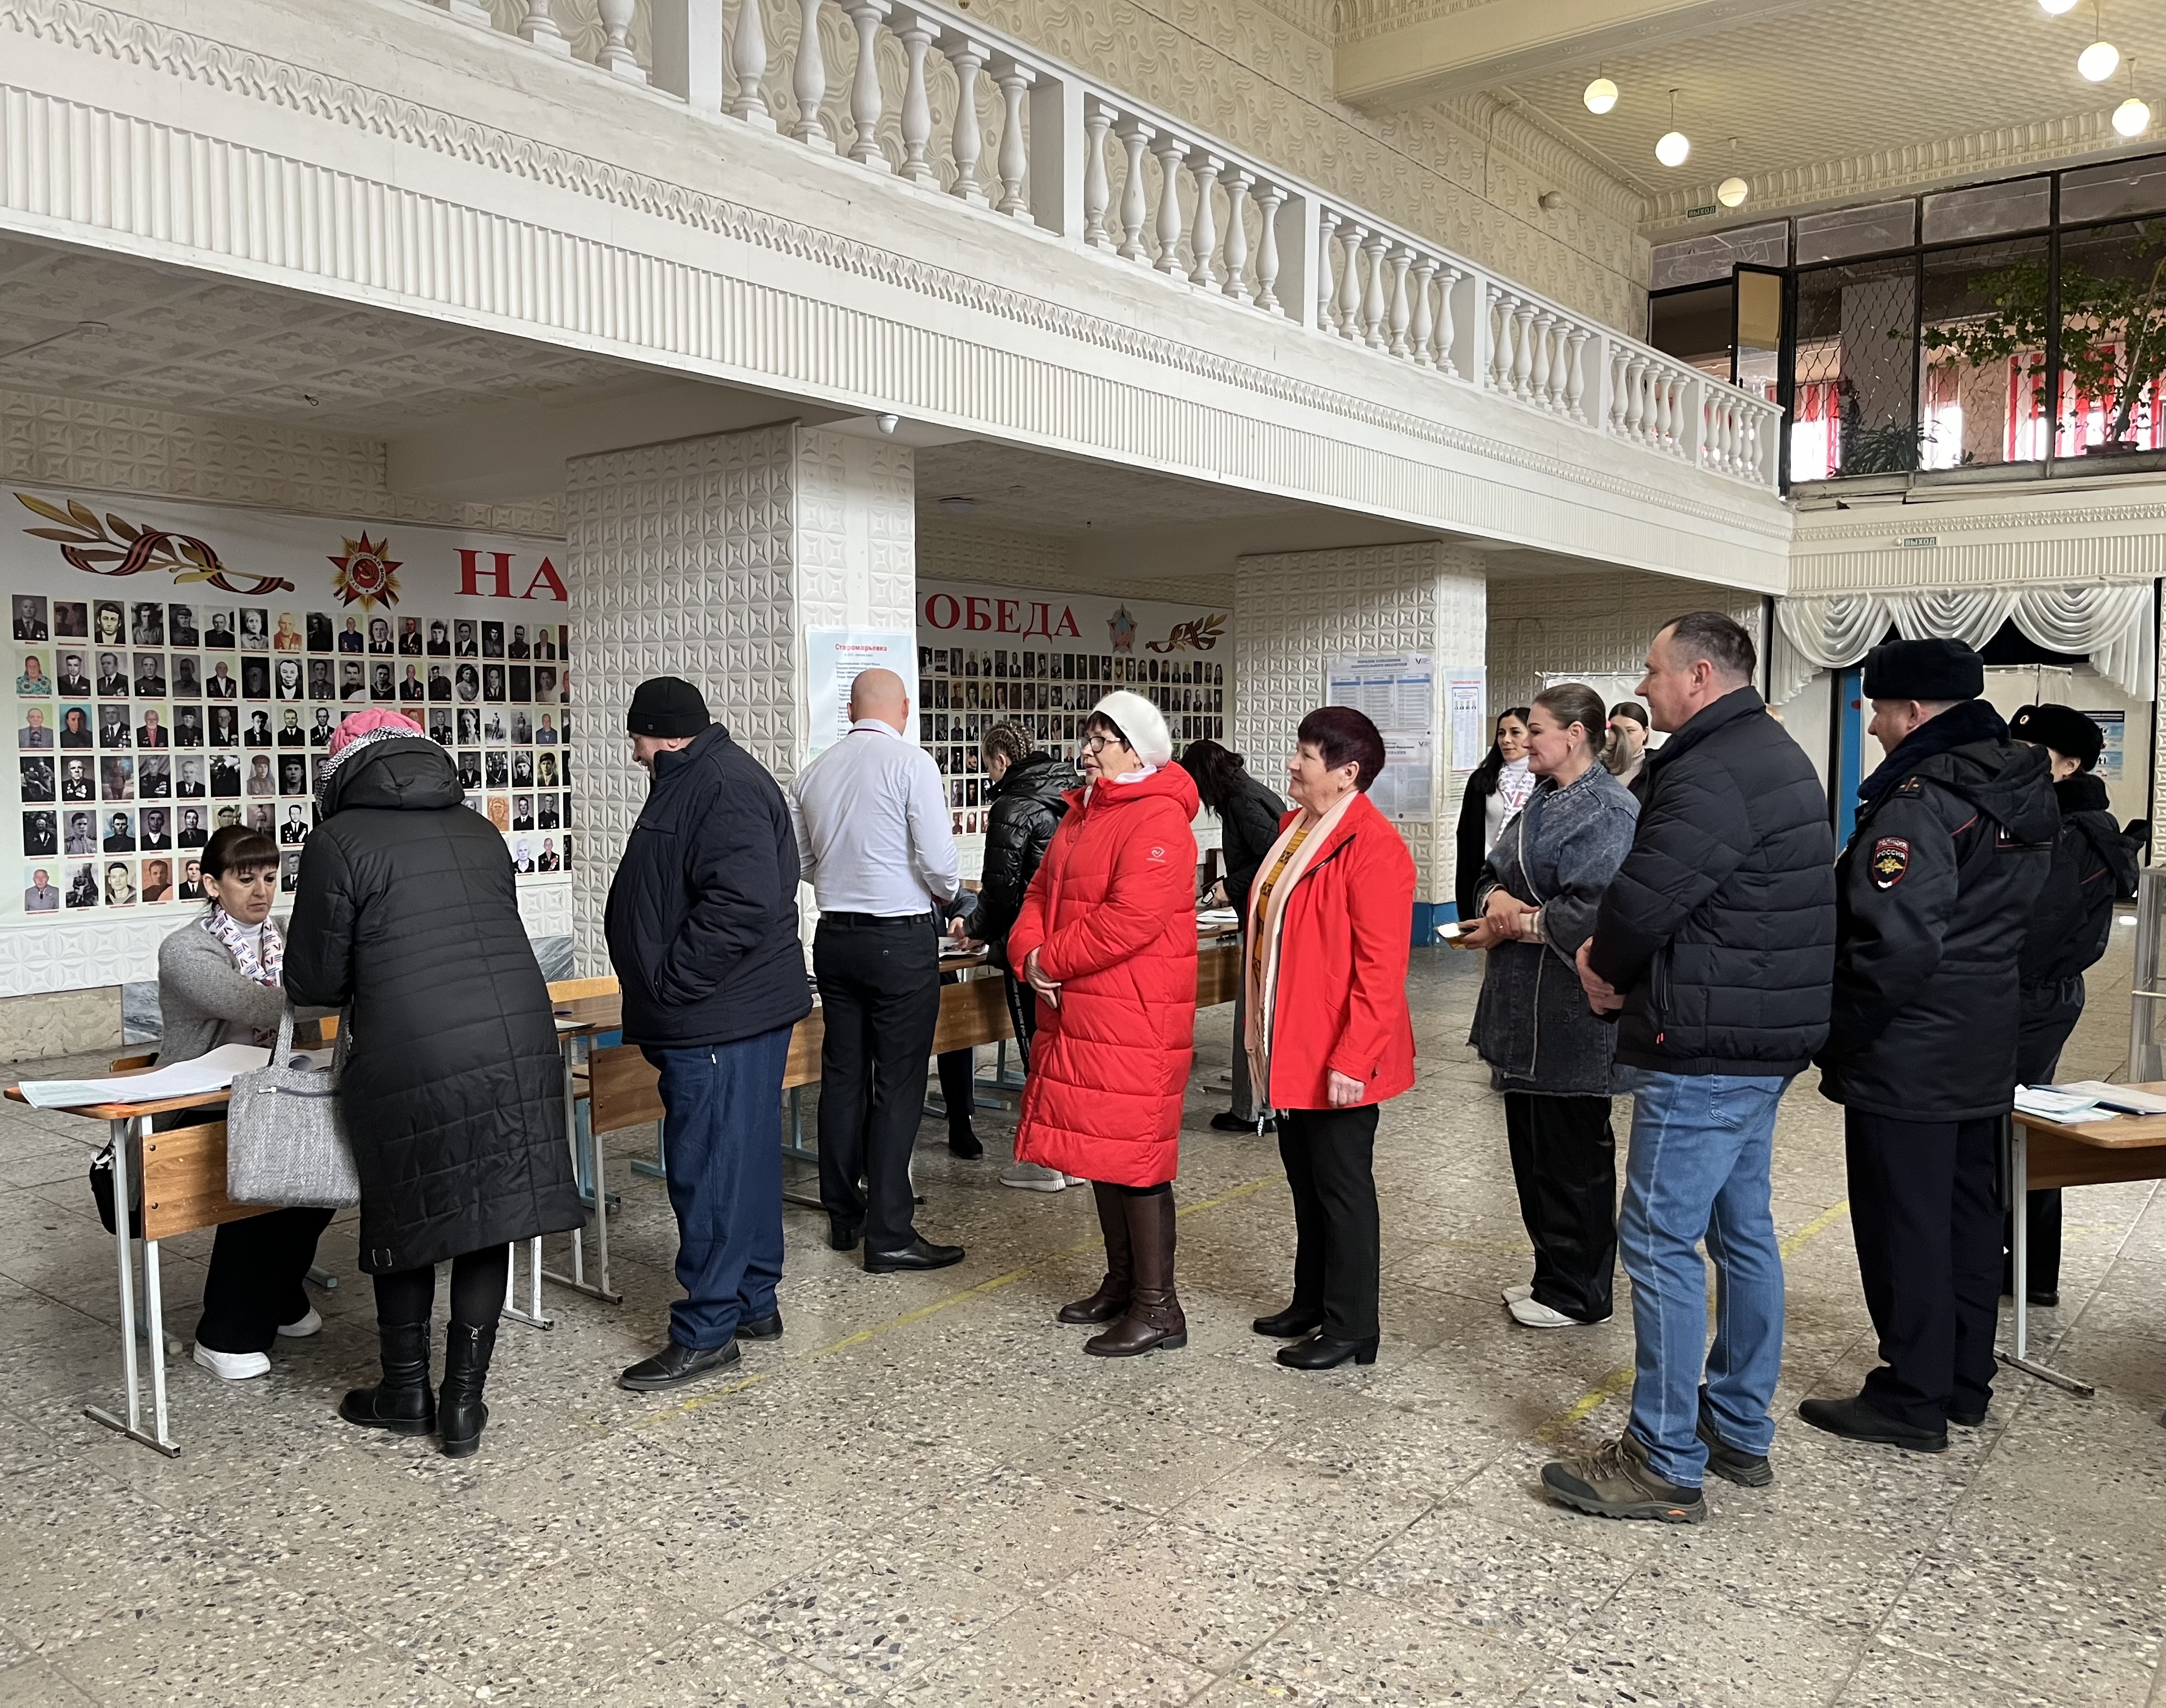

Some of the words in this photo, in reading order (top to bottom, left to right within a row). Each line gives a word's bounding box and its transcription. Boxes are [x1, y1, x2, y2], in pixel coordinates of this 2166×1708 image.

[1688, 206, 1715, 218] ВЫХОД
[1905, 537, 1936, 546] ВЫХОД
[453, 548, 567, 602] НА
[835, 643, 888, 652] Старомарьевка
[1878, 839, 1907, 849] ПОЛИЦИЯ
[1877, 849, 1906, 860] РОССИЯ
